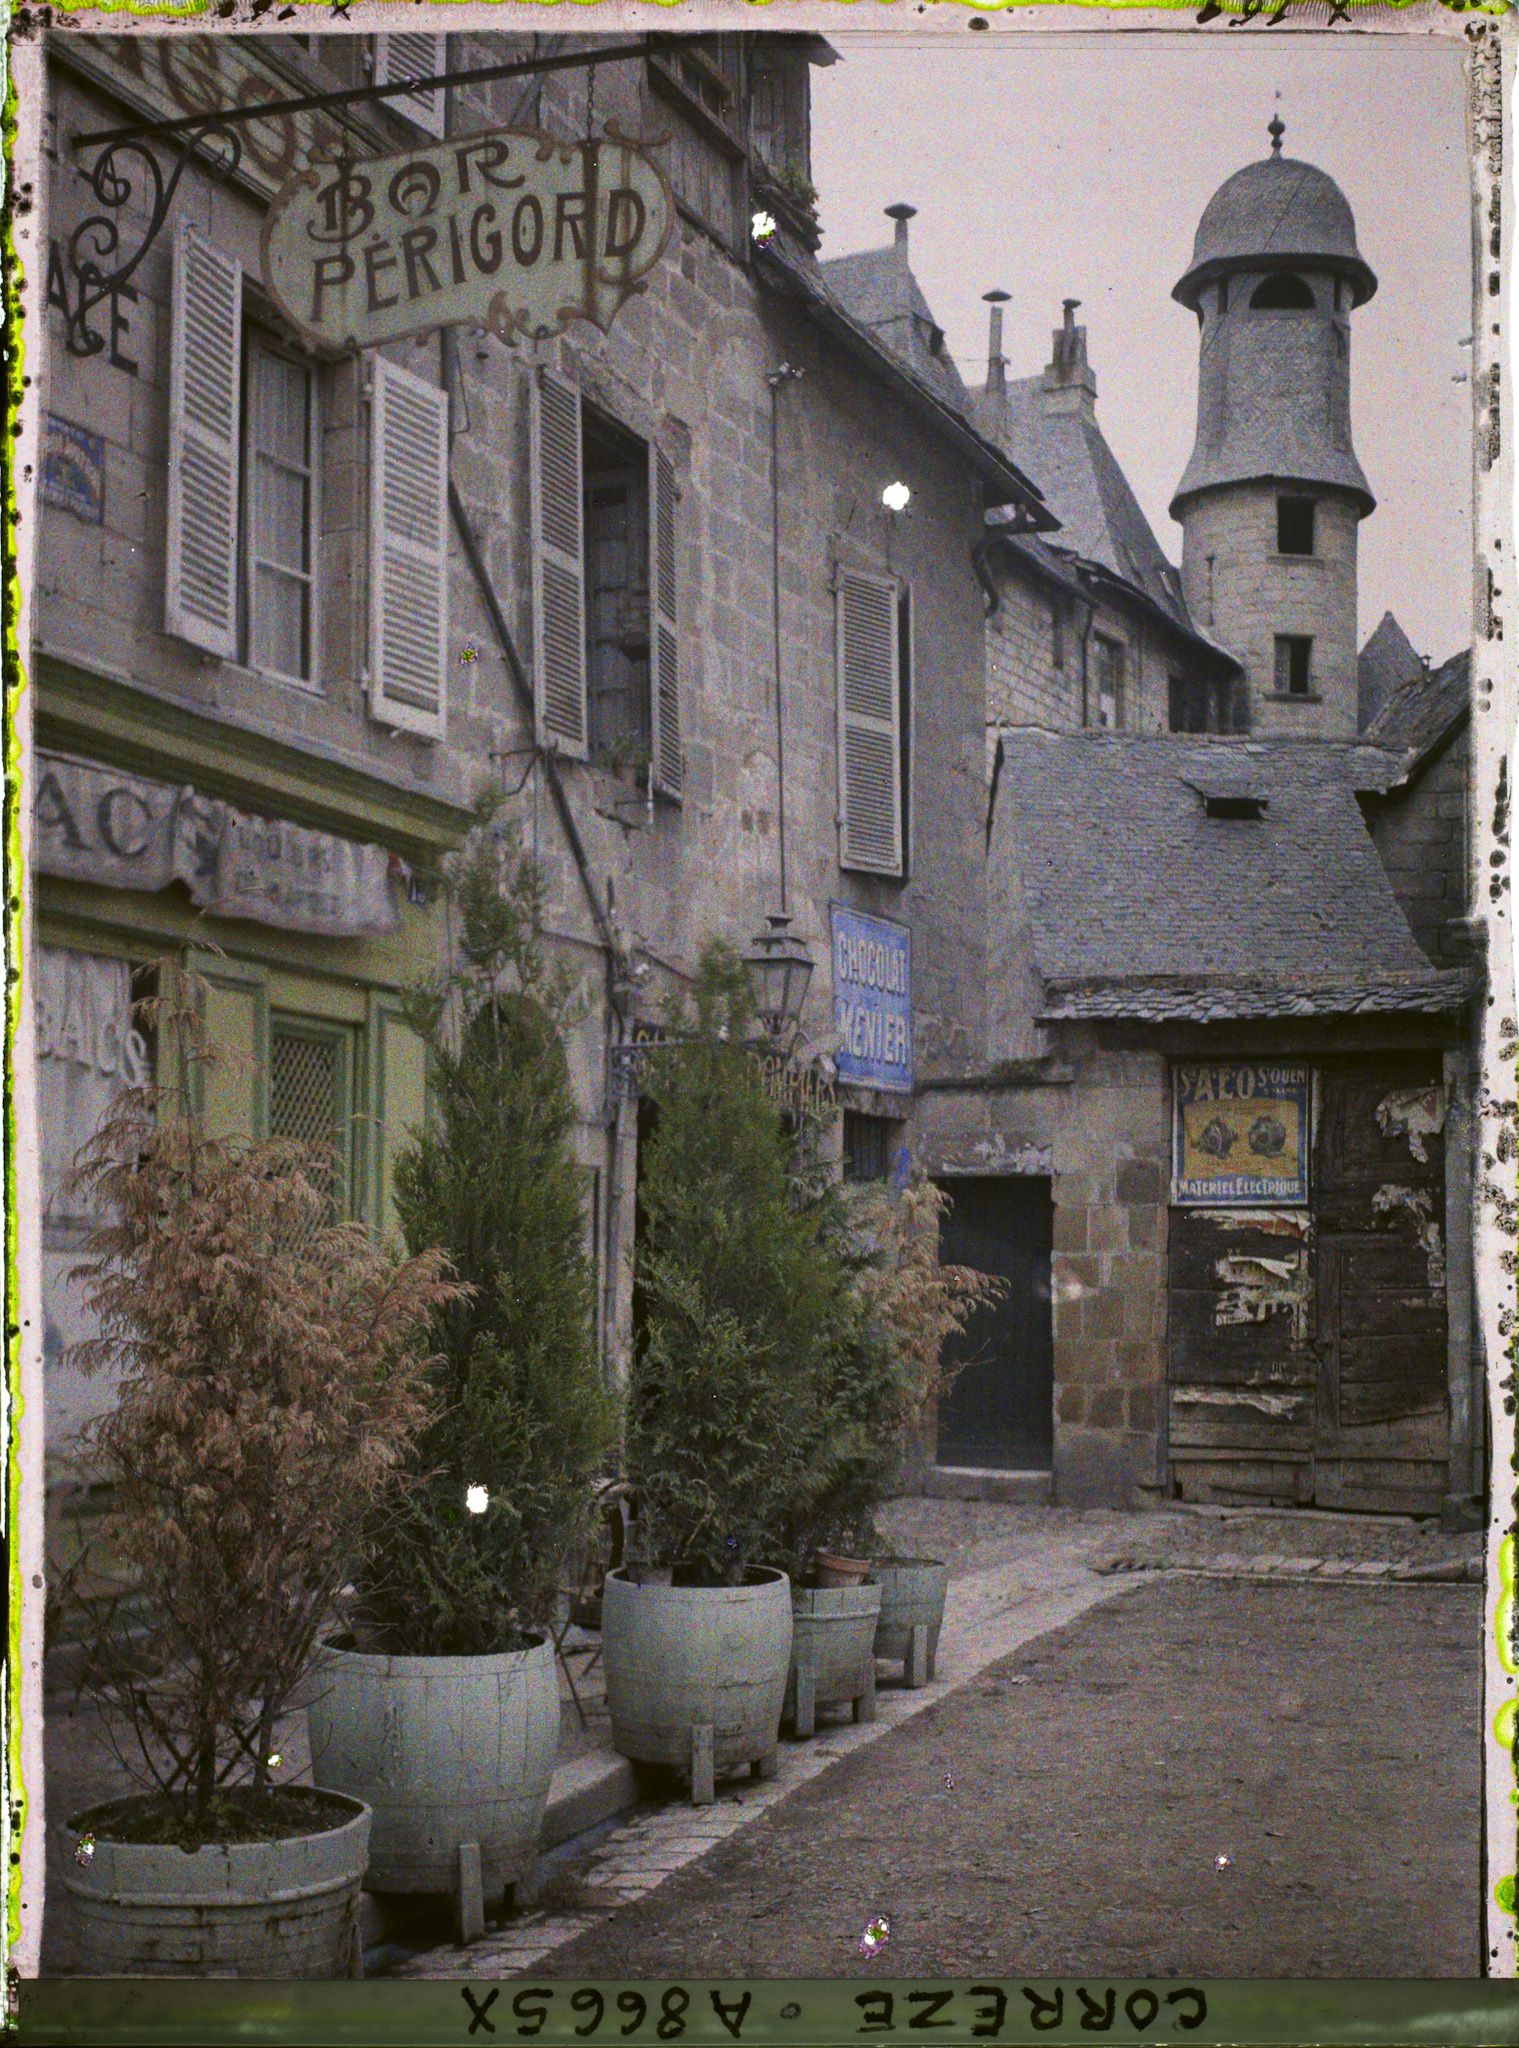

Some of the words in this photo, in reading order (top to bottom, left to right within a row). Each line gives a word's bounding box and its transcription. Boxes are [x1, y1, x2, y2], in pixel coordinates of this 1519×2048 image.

[306, 140, 526, 244] BAR
[837, 931, 906, 993] CHOCOLAT
[839, 999, 907, 1065] MENIER
